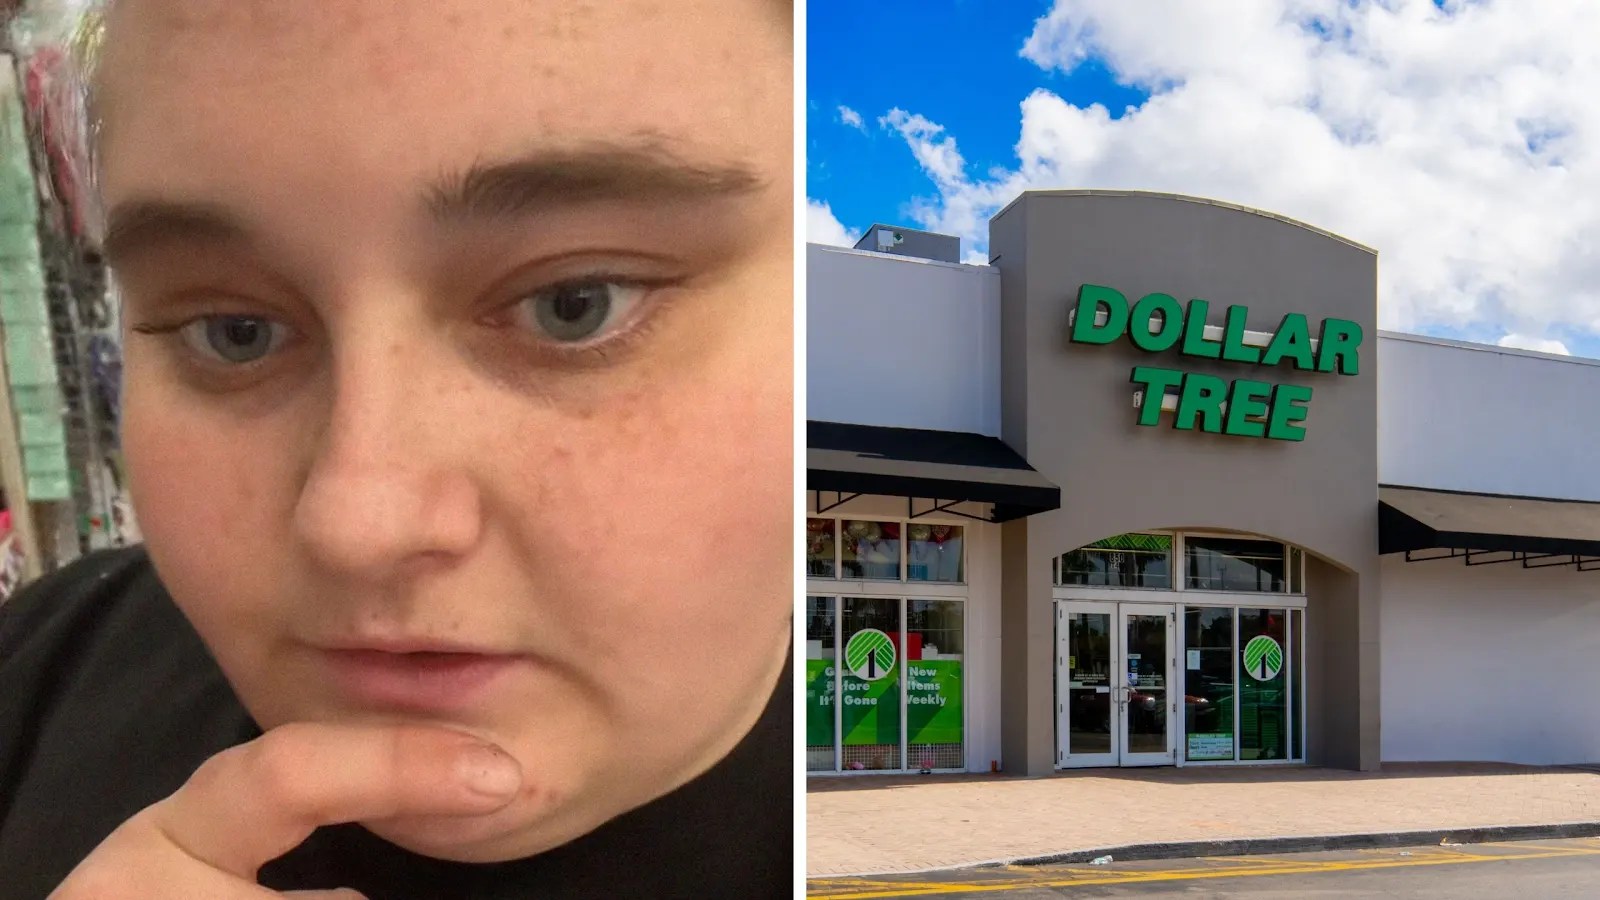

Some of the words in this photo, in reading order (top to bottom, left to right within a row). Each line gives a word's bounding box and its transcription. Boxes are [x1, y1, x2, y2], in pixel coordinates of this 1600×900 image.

[1070, 283, 1363, 376] DOLLAR
[1129, 366, 1313, 442] TREE
[909, 666, 937, 677] New
[844, 695, 878, 706] Gone
